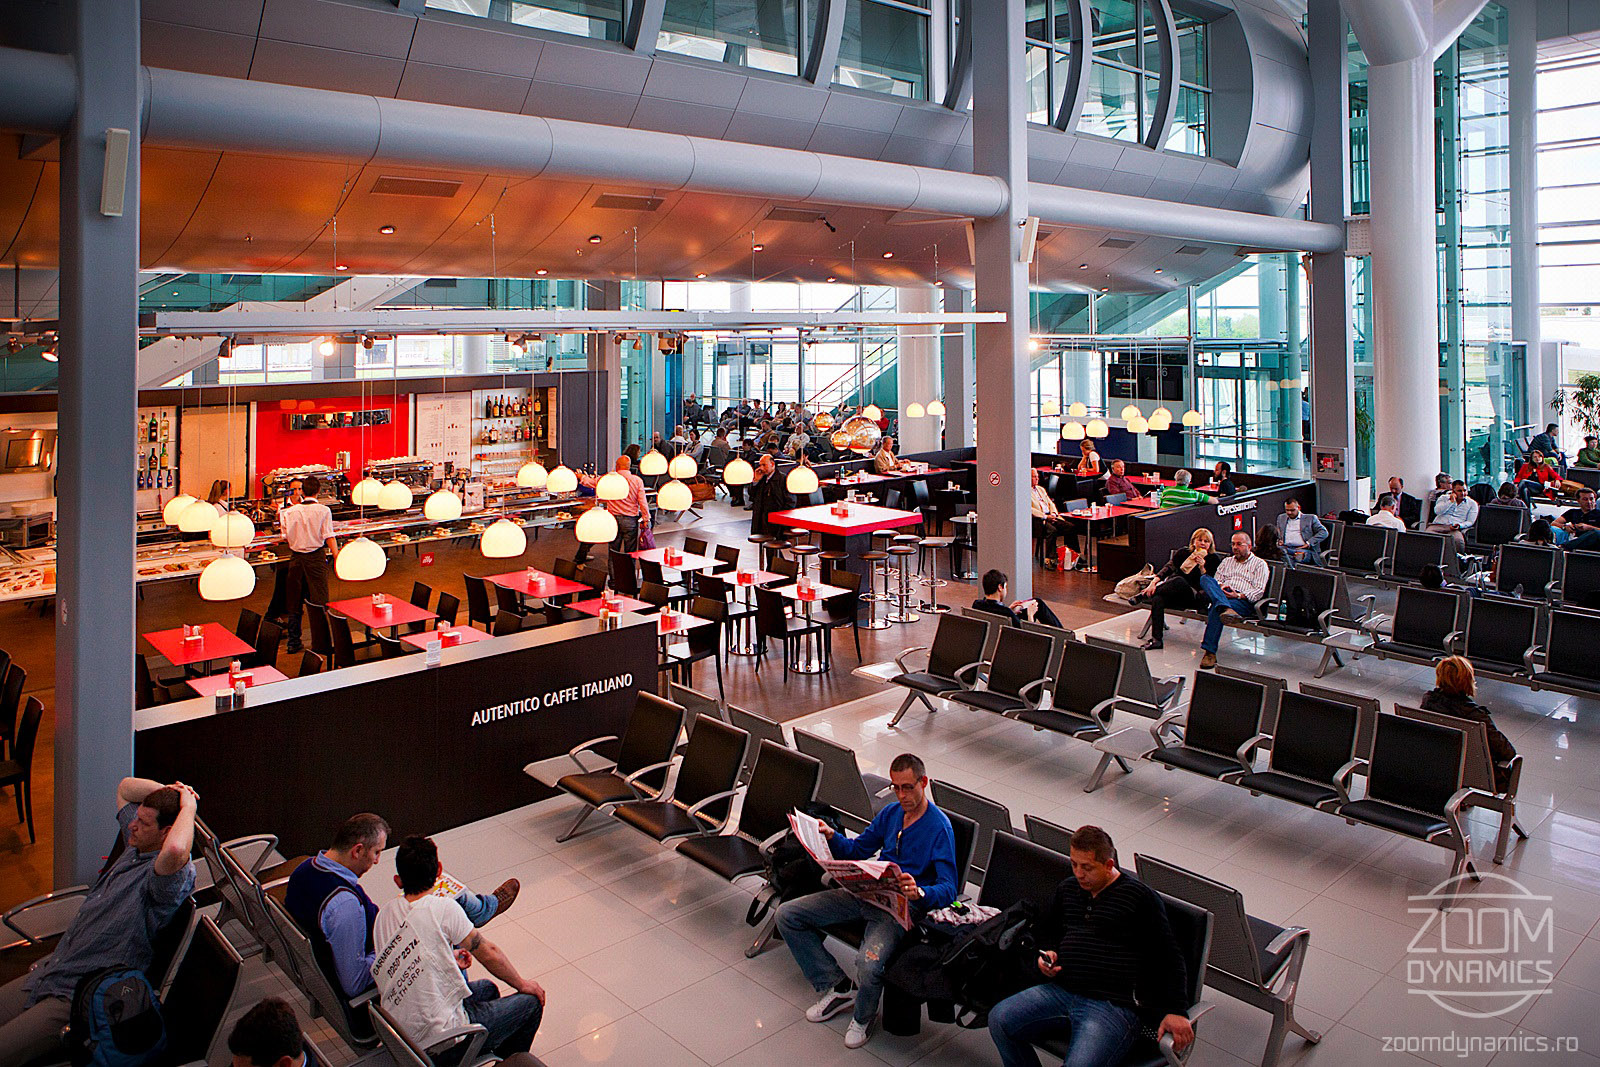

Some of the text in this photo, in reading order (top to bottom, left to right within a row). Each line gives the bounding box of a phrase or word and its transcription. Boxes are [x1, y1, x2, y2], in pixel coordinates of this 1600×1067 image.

[1122, 366, 1132, 376] 15
[471, 673, 633, 726] AUTENTICO CAFFE ITALIANO
[373, 934, 402, 976] GARMENTS
[387, 956, 422, 1002] THE CUSTOM
[394, 986, 408, 1006] CLTH
